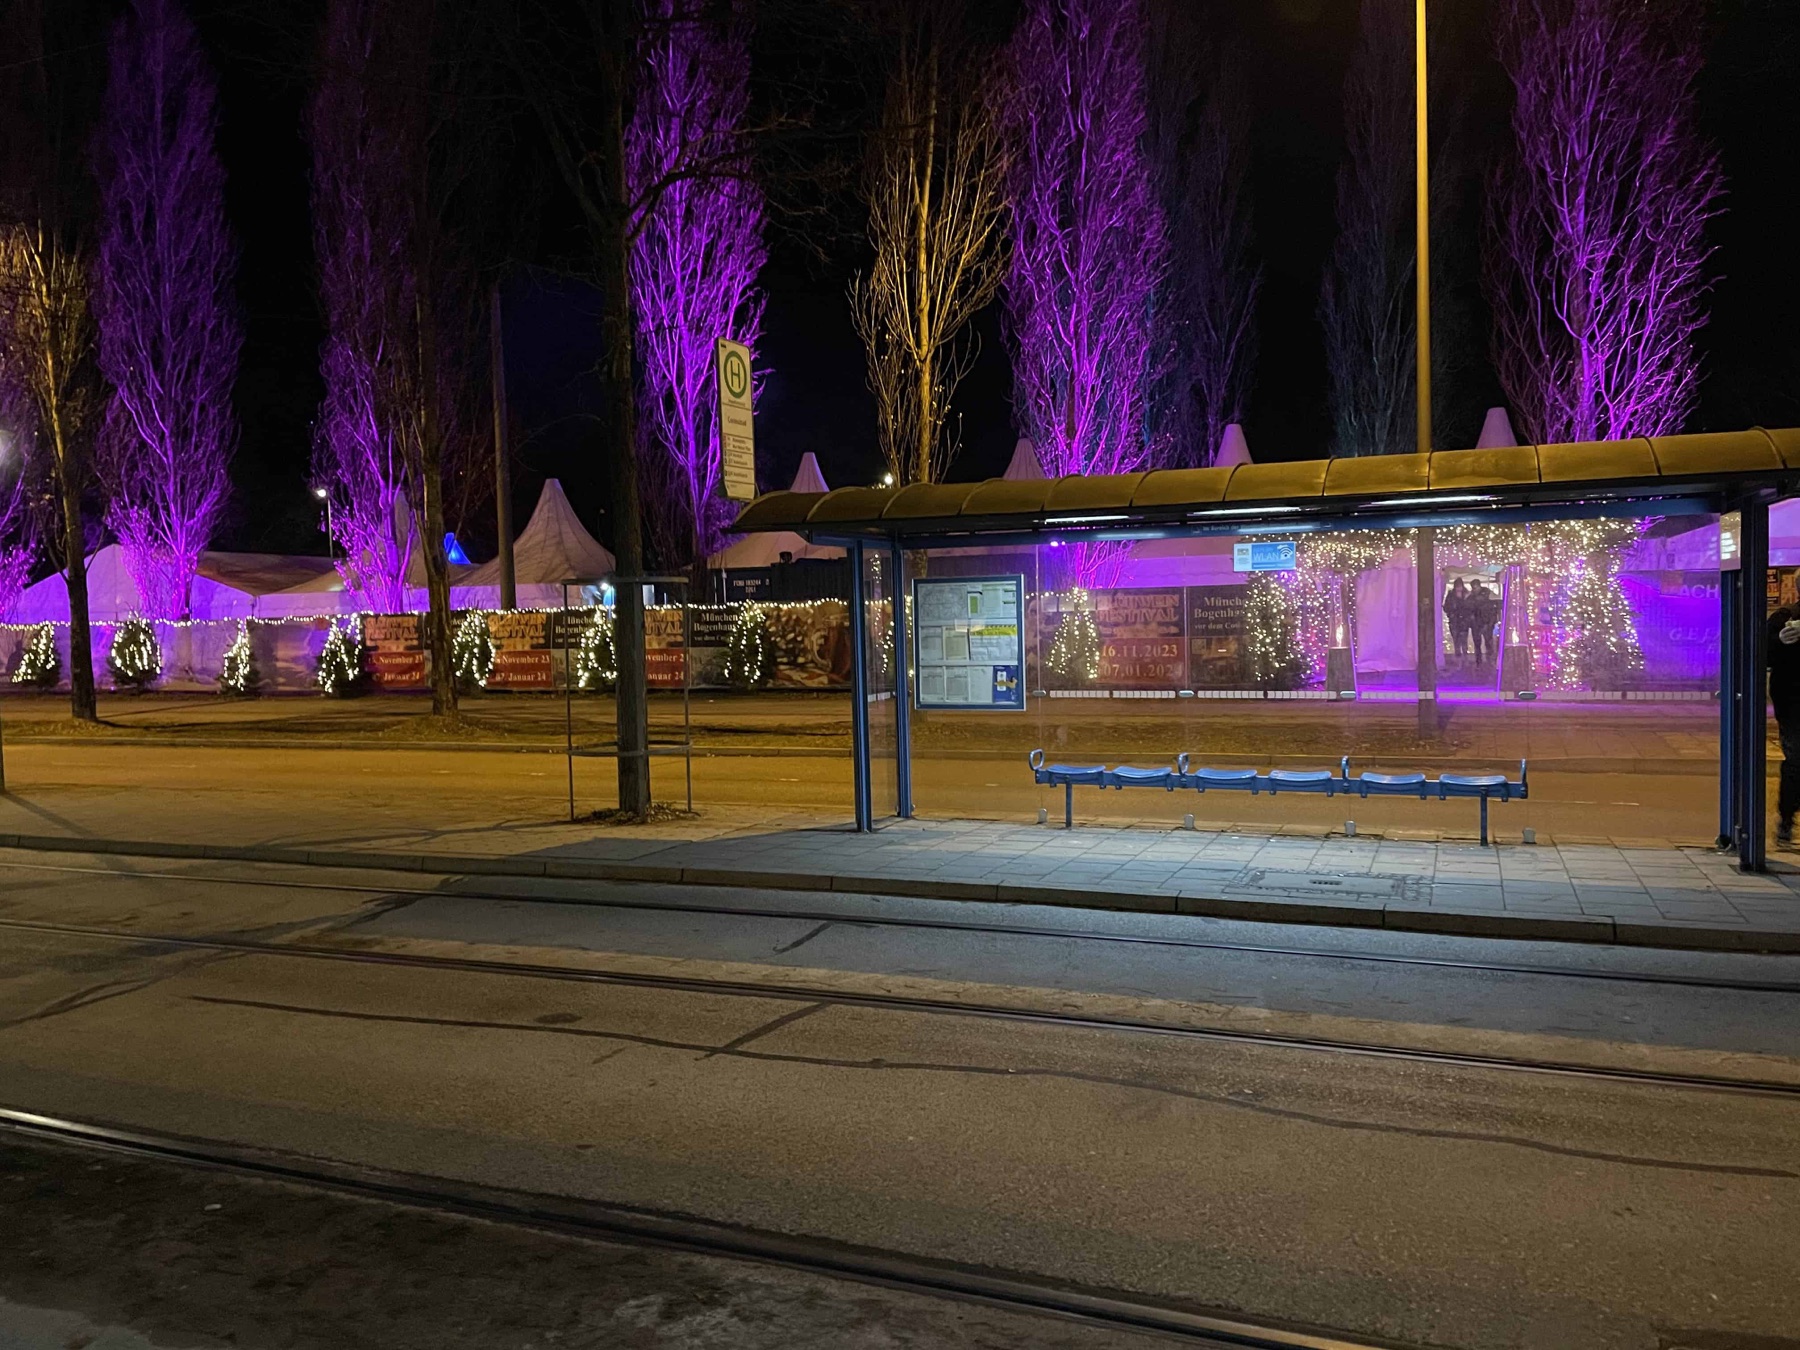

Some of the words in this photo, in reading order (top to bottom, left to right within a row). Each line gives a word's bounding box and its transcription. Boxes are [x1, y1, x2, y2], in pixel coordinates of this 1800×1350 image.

[730, 360, 741, 389] H
[1253, 551, 1280, 562] WLAN
[701, 612, 738, 622] München
[1101, 645, 1178, 657] 16.11.2023
[502, 655, 539, 664] November
[508, 672, 535, 681] Januar
[537, 671, 546, 681] 24
